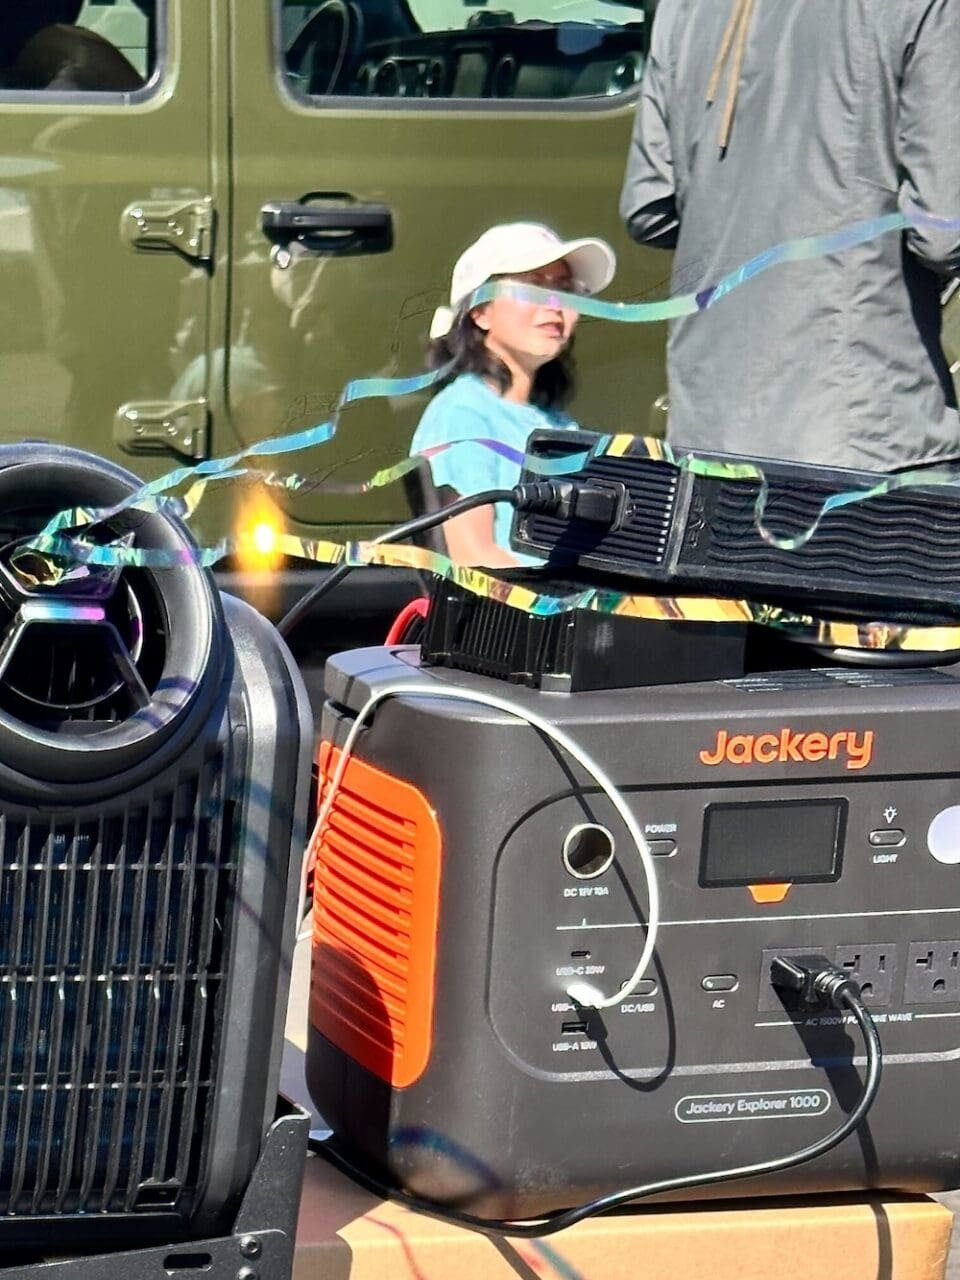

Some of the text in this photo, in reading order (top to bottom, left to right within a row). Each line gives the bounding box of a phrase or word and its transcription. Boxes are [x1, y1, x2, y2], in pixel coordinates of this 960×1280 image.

[699, 728, 874, 769] Jackery
[644, 824, 677, 834] POWER
[872, 853, 899, 864] LIGHT
[563, 888, 578, 897] DC
[621, 1003, 655, 1013] DC/USB
[712, 999, 726, 1009] AC
[888, 1012, 913, 1022] WAVE
[686, 1095, 820, 1115] Jackery Explorer 1000
